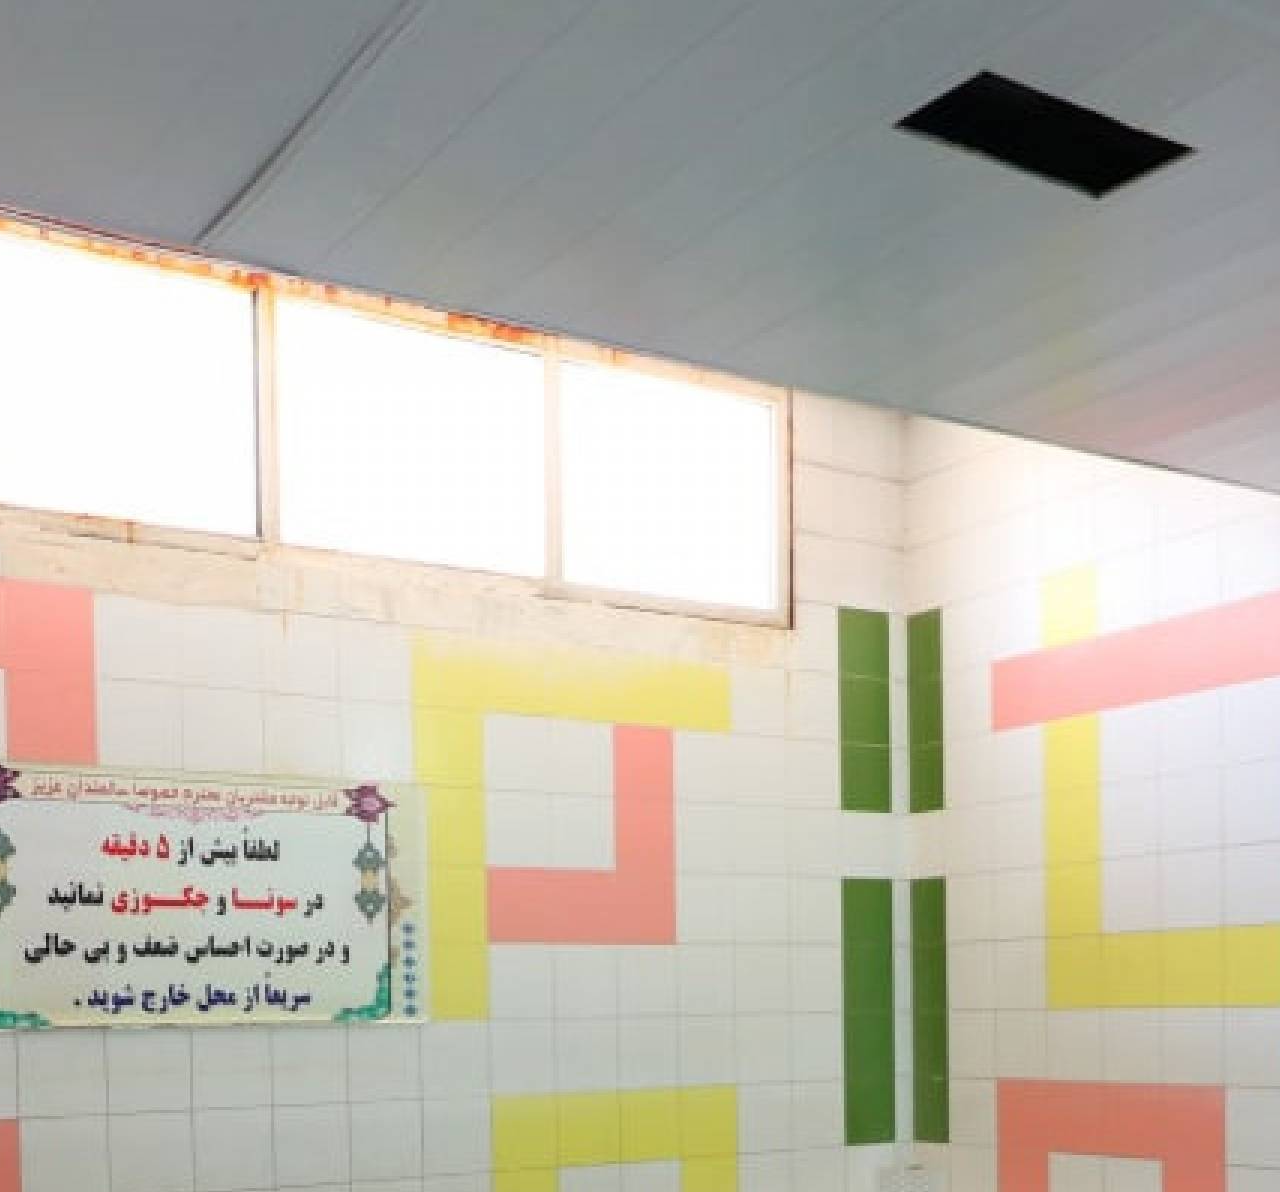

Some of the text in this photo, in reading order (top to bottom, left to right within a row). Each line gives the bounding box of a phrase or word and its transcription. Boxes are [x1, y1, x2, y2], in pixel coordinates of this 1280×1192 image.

[100, 831, 151, 862] دقیقه
[156, 834, 170, 859] ۵
[177, 836, 195, 867] از
[199, 837, 239, 867] بیش
[47, 881, 104, 913] نمانید
[215, 894, 227, 916] و
[303, 893, 323, 918] در
[23, 932, 77, 964] حالی
[115, 941, 128, 964] و
[132, 934, 179, 957] ضعف
[184, 935, 252, 964] احساس
[255, 938, 309, 964] صورت
[315, 941, 335, 964] در
[340, 943, 351, 964] و
[140, 983, 191, 1014] خارج
[195, 983, 239, 1012] محل
[242, 983, 260, 1014] از
